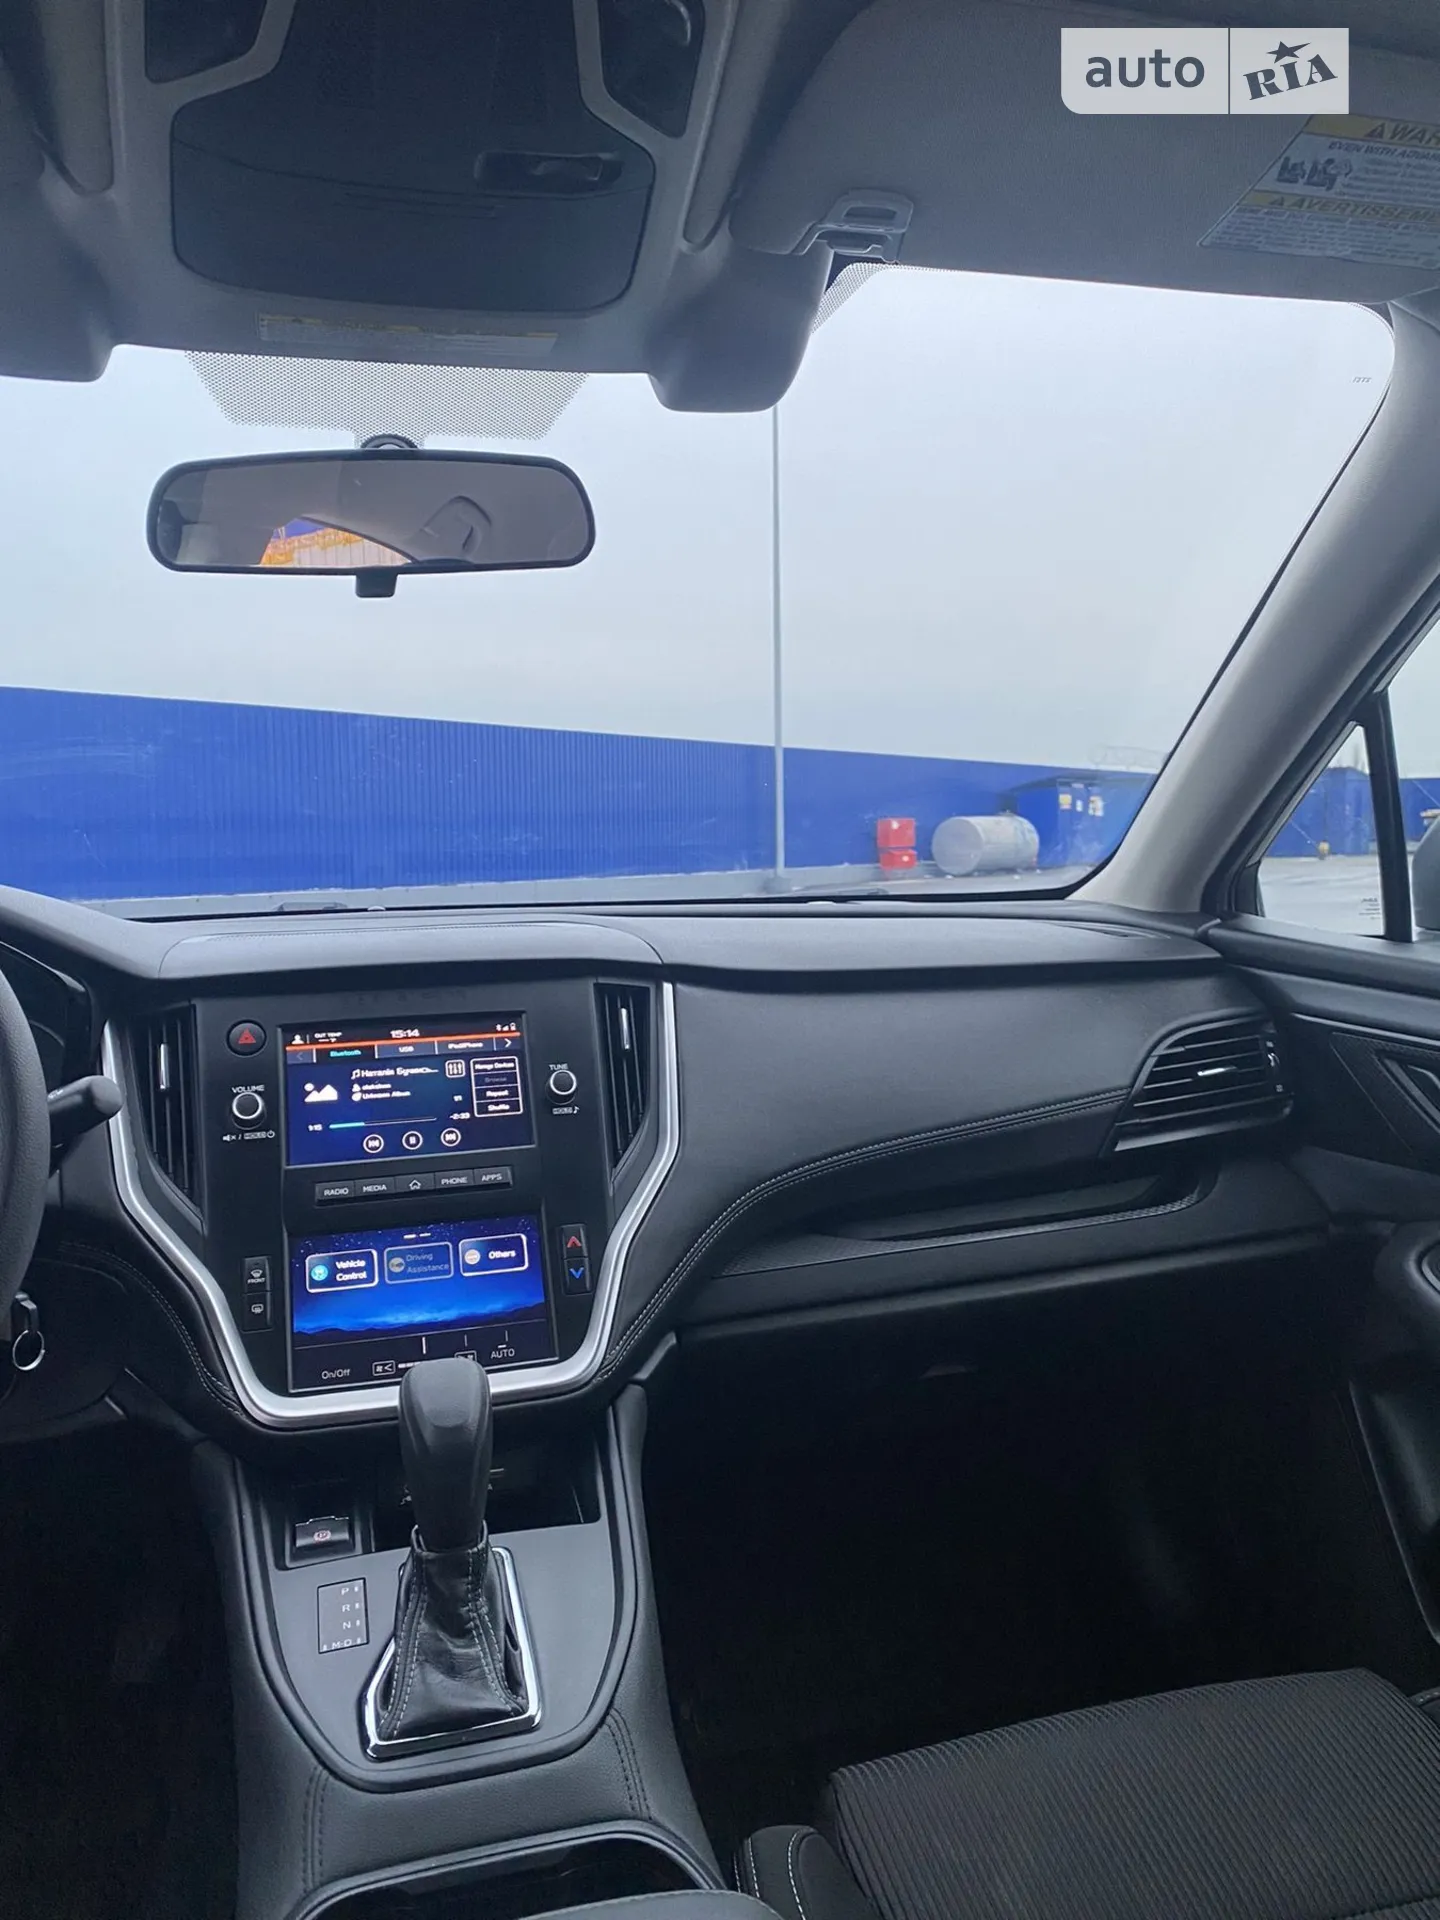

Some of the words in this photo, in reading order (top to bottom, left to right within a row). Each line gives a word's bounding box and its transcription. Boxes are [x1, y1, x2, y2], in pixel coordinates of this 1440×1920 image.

[390, 1028, 420, 1039] 15:14
[548, 1063, 569, 1071] TUNE
[231, 1084, 265, 1094] VOLUME
[323, 1187, 349, 1196] RADIO
[362, 1183, 388, 1193] MEDIA
[441, 1176, 469, 1185] PHONE
[481, 1172, 503, 1182] APPS
[405, 1253, 434, 1263] Driving
[488, 1250, 517, 1260] Others
[335, 1259, 366, 1270] Vehicle
[406, 1264, 450, 1274] Assistance
[335, 1271, 368, 1282] Control
[321, 1368, 351, 1380] On/Off
[490, 1348, 515, 1360] AUTO
[341, 1587, 350, 1596] P
[342, 1604, 351, 1613] R
[342, 1620, 351, 1630] N
